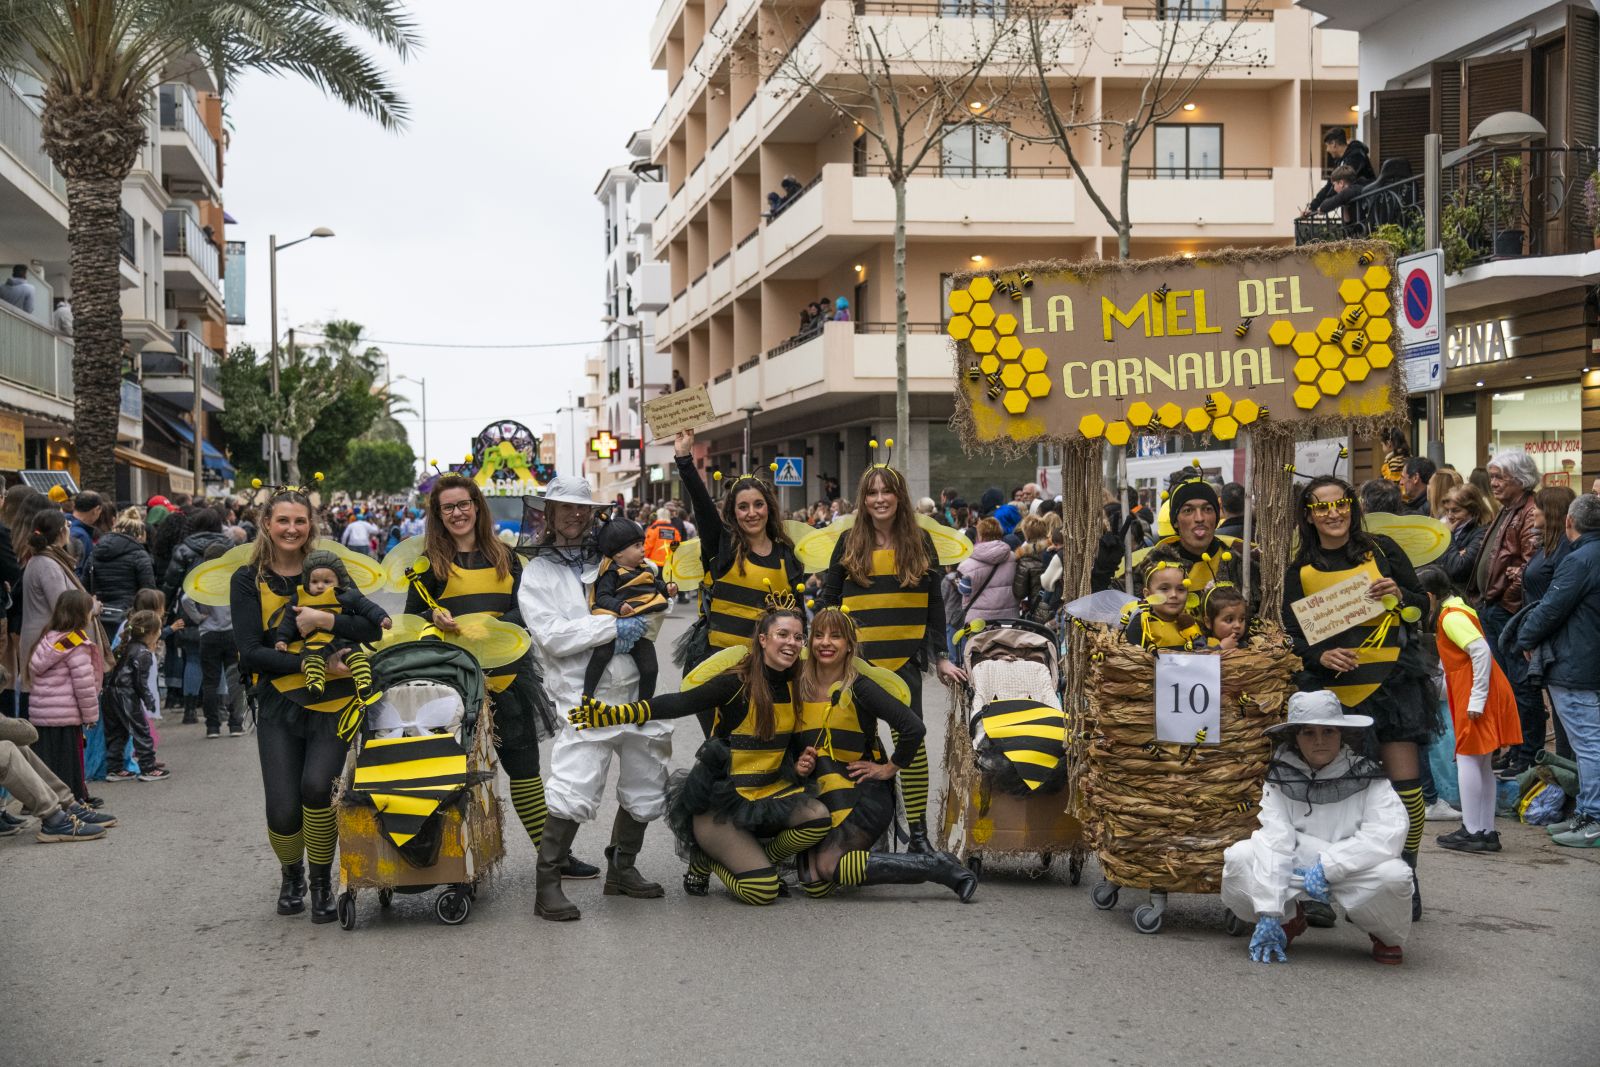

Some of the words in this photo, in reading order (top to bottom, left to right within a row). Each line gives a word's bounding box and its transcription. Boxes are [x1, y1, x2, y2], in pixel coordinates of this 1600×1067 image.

[1022, 295, 1074, 334] LA
[1101, 289, 1222, 341] MIEL
[1238, 275, 1314, 318] DEL
[1062, 347, 1285, 399] CARNAVAL
[1169, 682, 1210, 714] 10
